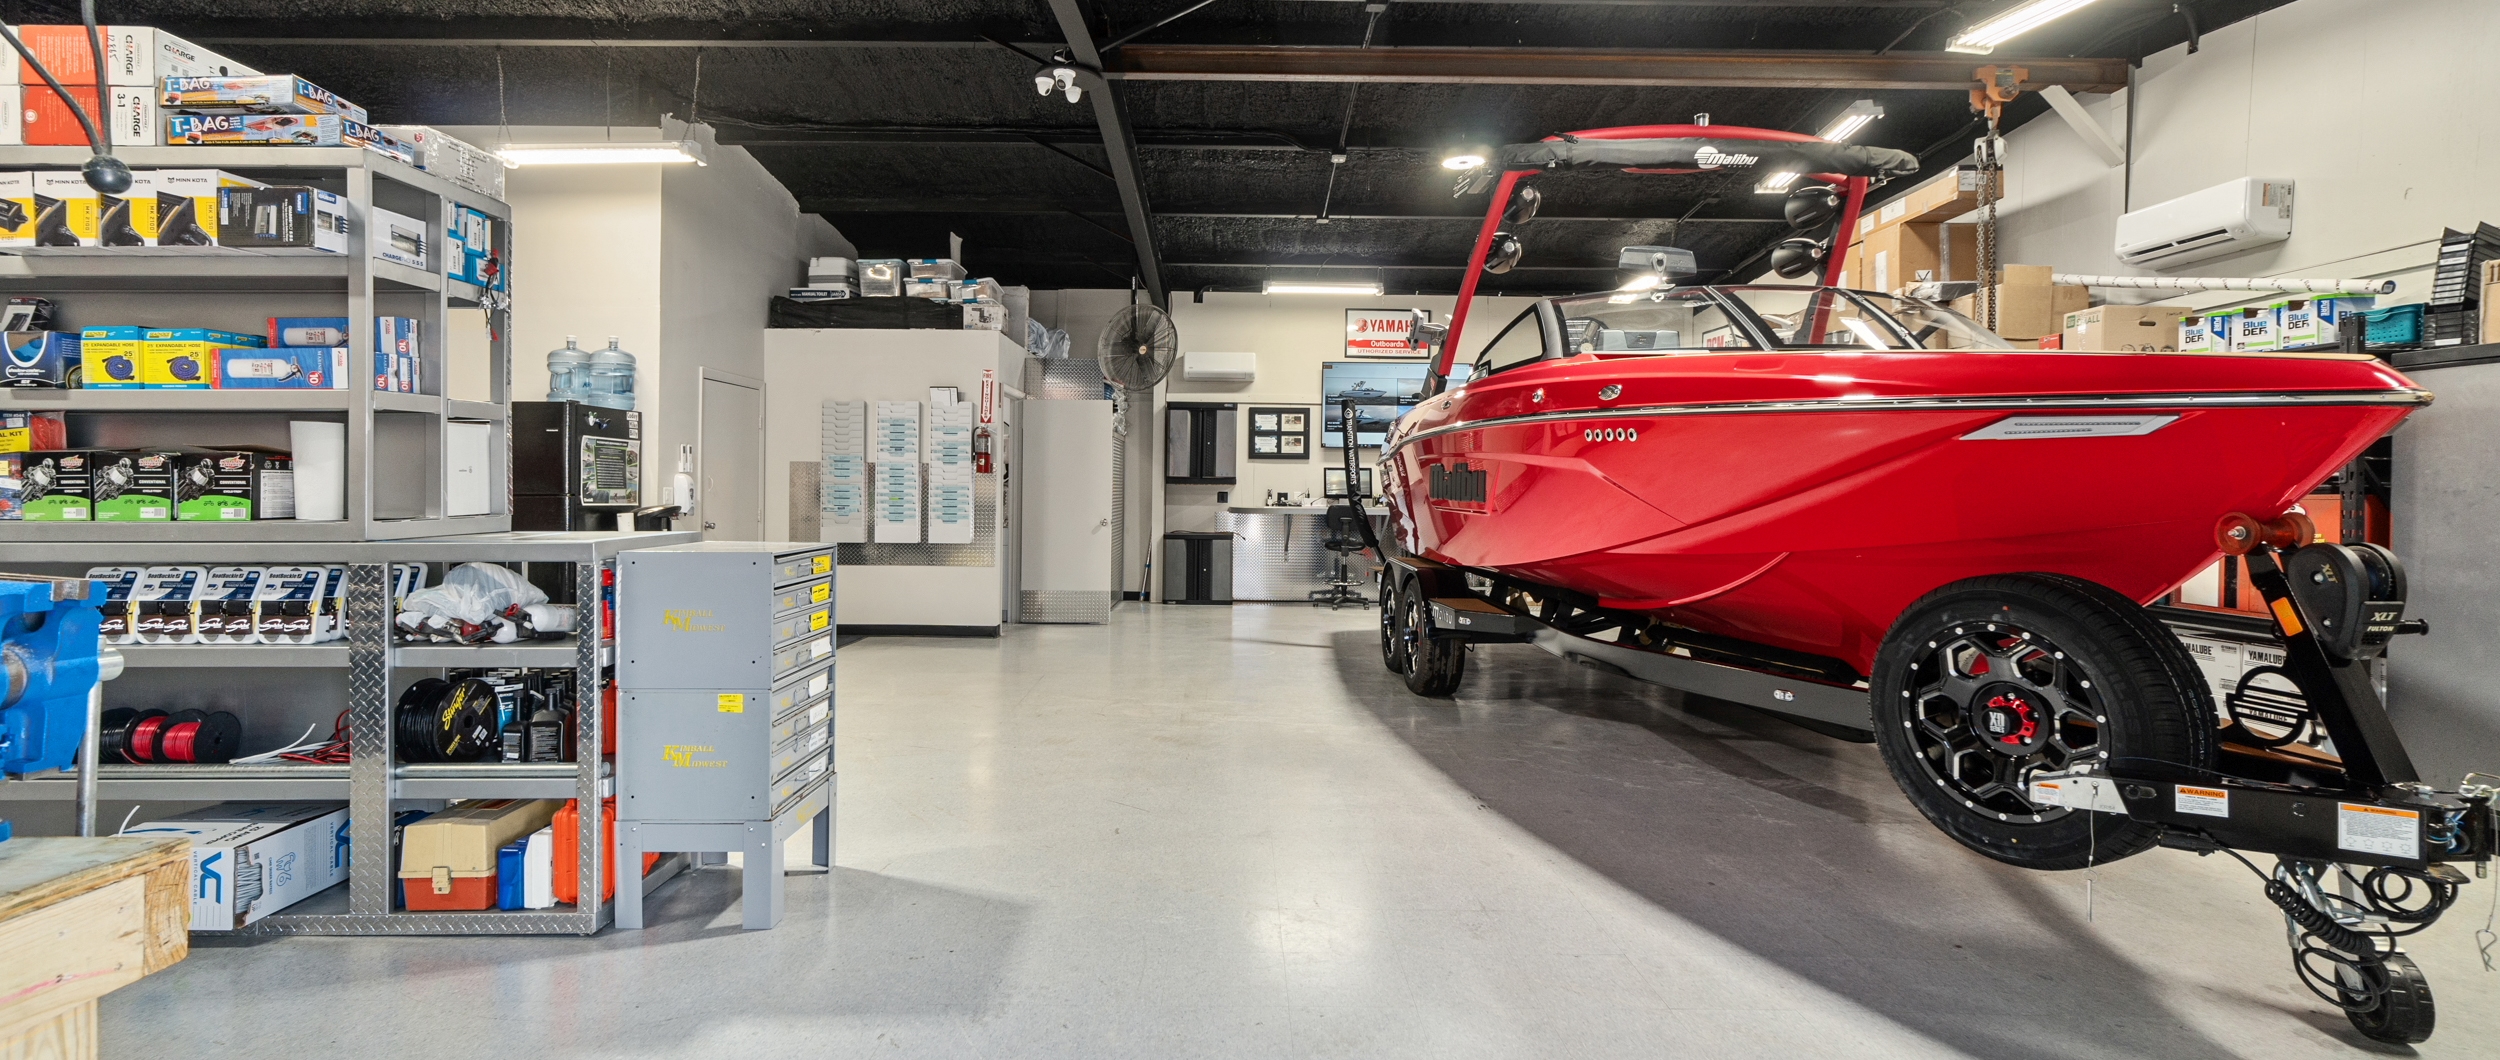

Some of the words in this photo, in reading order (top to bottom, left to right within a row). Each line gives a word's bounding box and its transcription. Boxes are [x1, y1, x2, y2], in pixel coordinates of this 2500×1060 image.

[164, 44, 195, 62] CHARGE
[165, 78, 210, 91] T-BAG
[297, 80, 333, 105] T-BAG
[171, 116, 229, 132] T-BAG
[344, 121, 380, 141] T-BAG
[1706, 154, 1759, 165] Malibu
[208, 204, 213, 213] MK
[399, 341, 407, 351] 10
[309, 374, 318, 382] 10
[378, 376, 385, 386] 10
[1348, 449, 1357, 485] WATERSPORTS
[663, 609, 714, 625] KIMBALL
[2370, 612, 2398, 621] XLT
[672, 617, 726, 632] MIDWEST
[1989, 712, 2005, 726] XD
[662, 745, 715, 760] KIMBALL
[672, 752, 728, 768] MIDWEST
[2187, 788, 2224, 798] WARNING
[200, 851, 222, 905] VC
